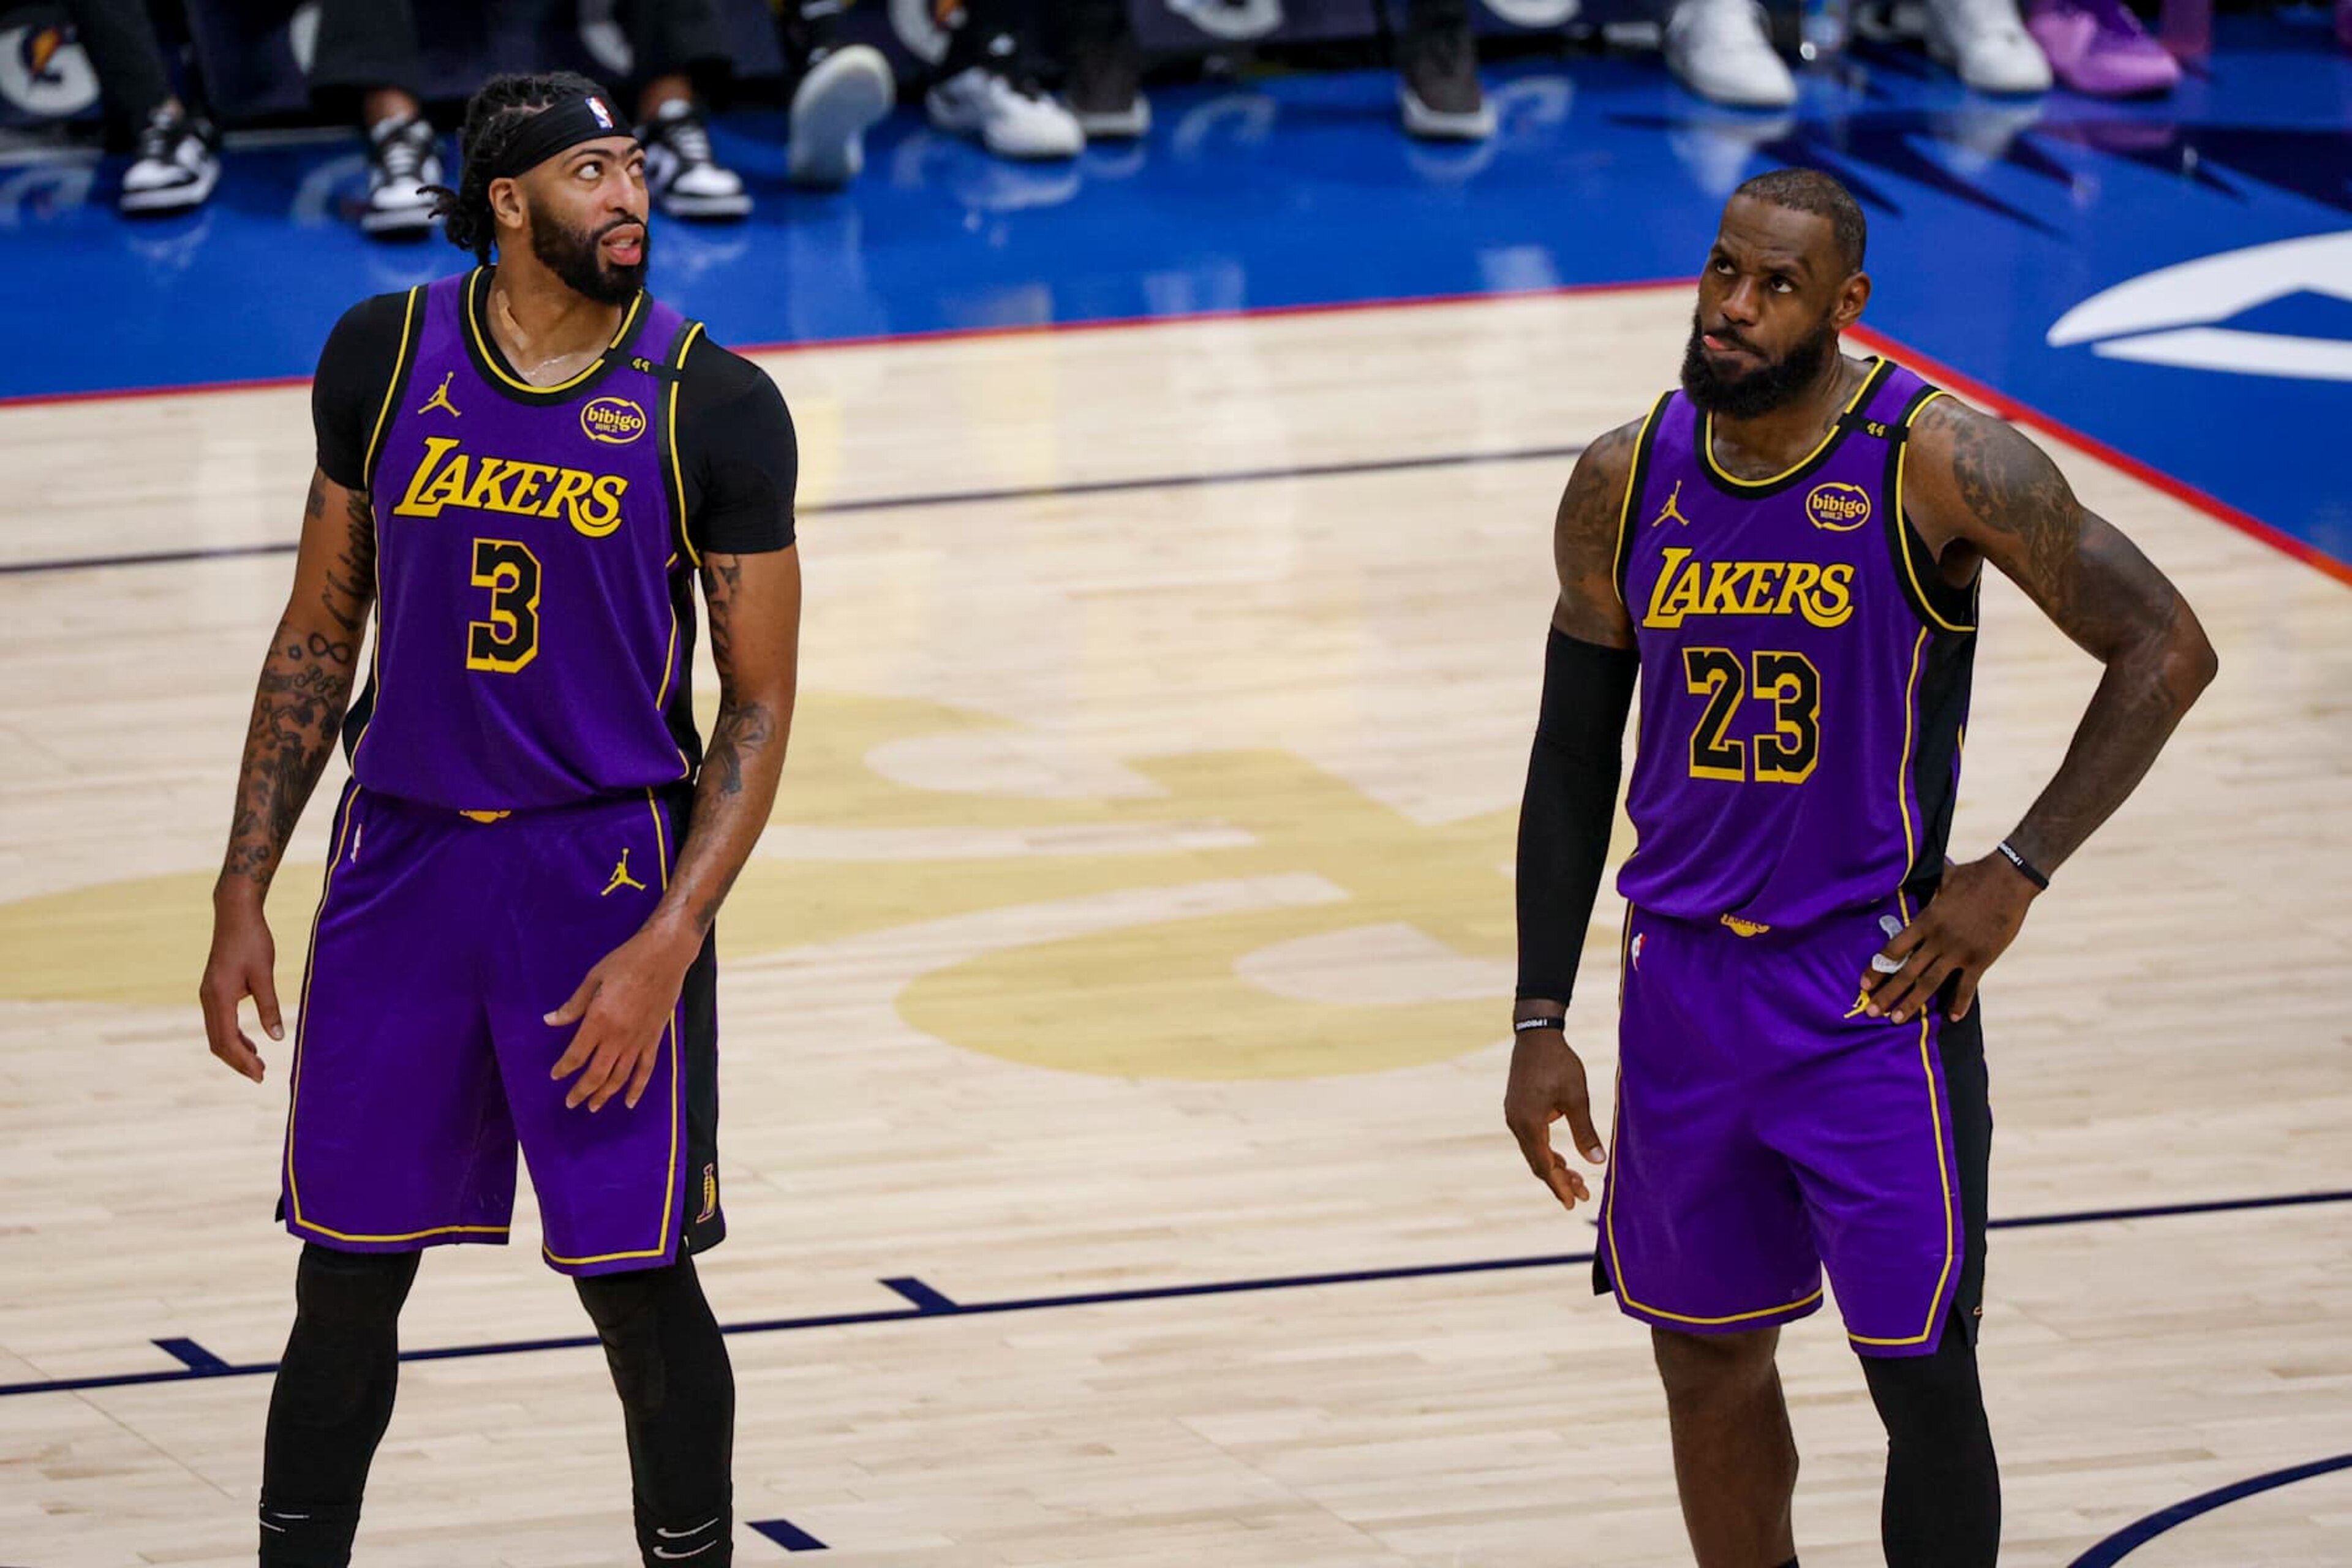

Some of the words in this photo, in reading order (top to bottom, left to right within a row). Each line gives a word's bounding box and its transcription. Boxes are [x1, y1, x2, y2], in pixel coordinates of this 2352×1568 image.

[587, 407, 641, 432] bibigo
[1867, 421, 1886, 437] 44
[393, 436, 629, 538] LAKERS
[1812, 493, 1867, 518] bibigo
[466, 538, 541, 674] 3
[1642, 548, 1855, 628] LAKERS
[1681, 646, 1820, 785] 23
